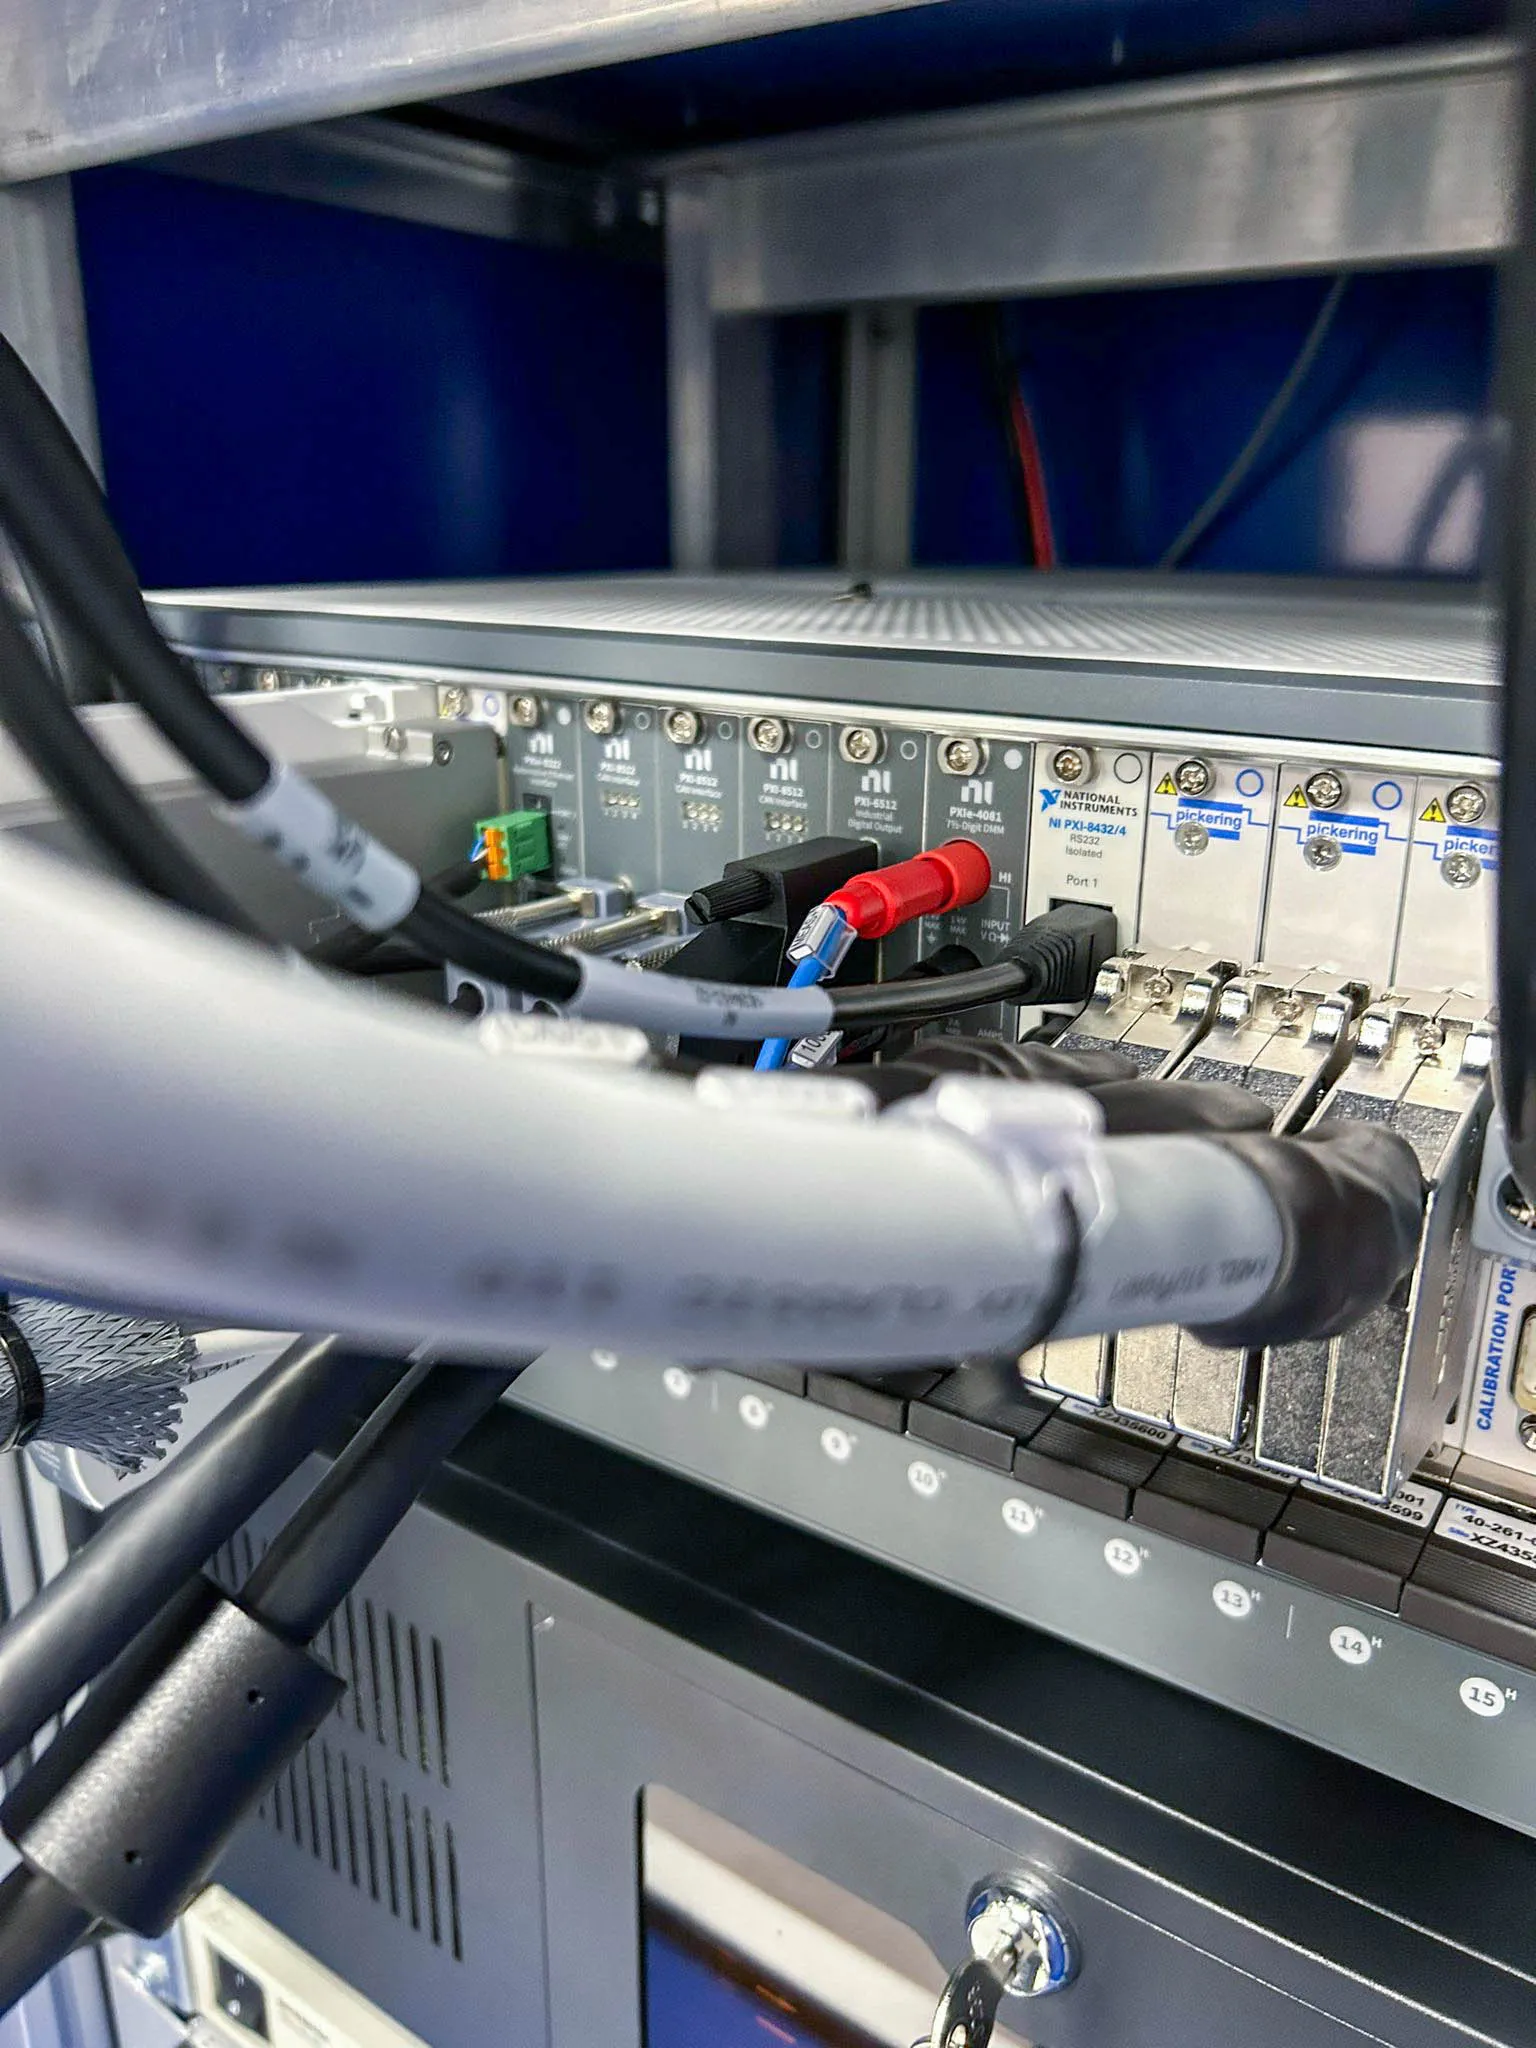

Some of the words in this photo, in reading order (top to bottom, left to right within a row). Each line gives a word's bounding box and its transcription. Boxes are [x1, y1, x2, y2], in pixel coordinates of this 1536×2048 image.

[1064, 790, 1120, 805] NATIONAL
[950, 807, 1002, 822] PXIe-4081
[1060, 800, 1138, 817] INSTRUMENTS
[1049, 817, 1061, 828] NI
[1064, 820, 1126, 836] PXI-8432/4
[1176, 808, 1242, 830] pickering
[1070, 834, 1100, 845] RS232
[1306, 823, 1379, 845] pickering
[1065, 846, 1102, 859] Isolated
[1444, 838, 1500, 855] picker
[1066, 874, 1088, 887] Port
[981, 919, 1011, 932] INPUT
[1477, 1310, 1509, 1431] CALIBRATION
[1112, 1547, 1133, 1565] 12
[1221, 1588, 1242, 1609] 13
[1338, 1635, 1362, 1655] 14
[1469, 1687, 1496, 1708] 15
